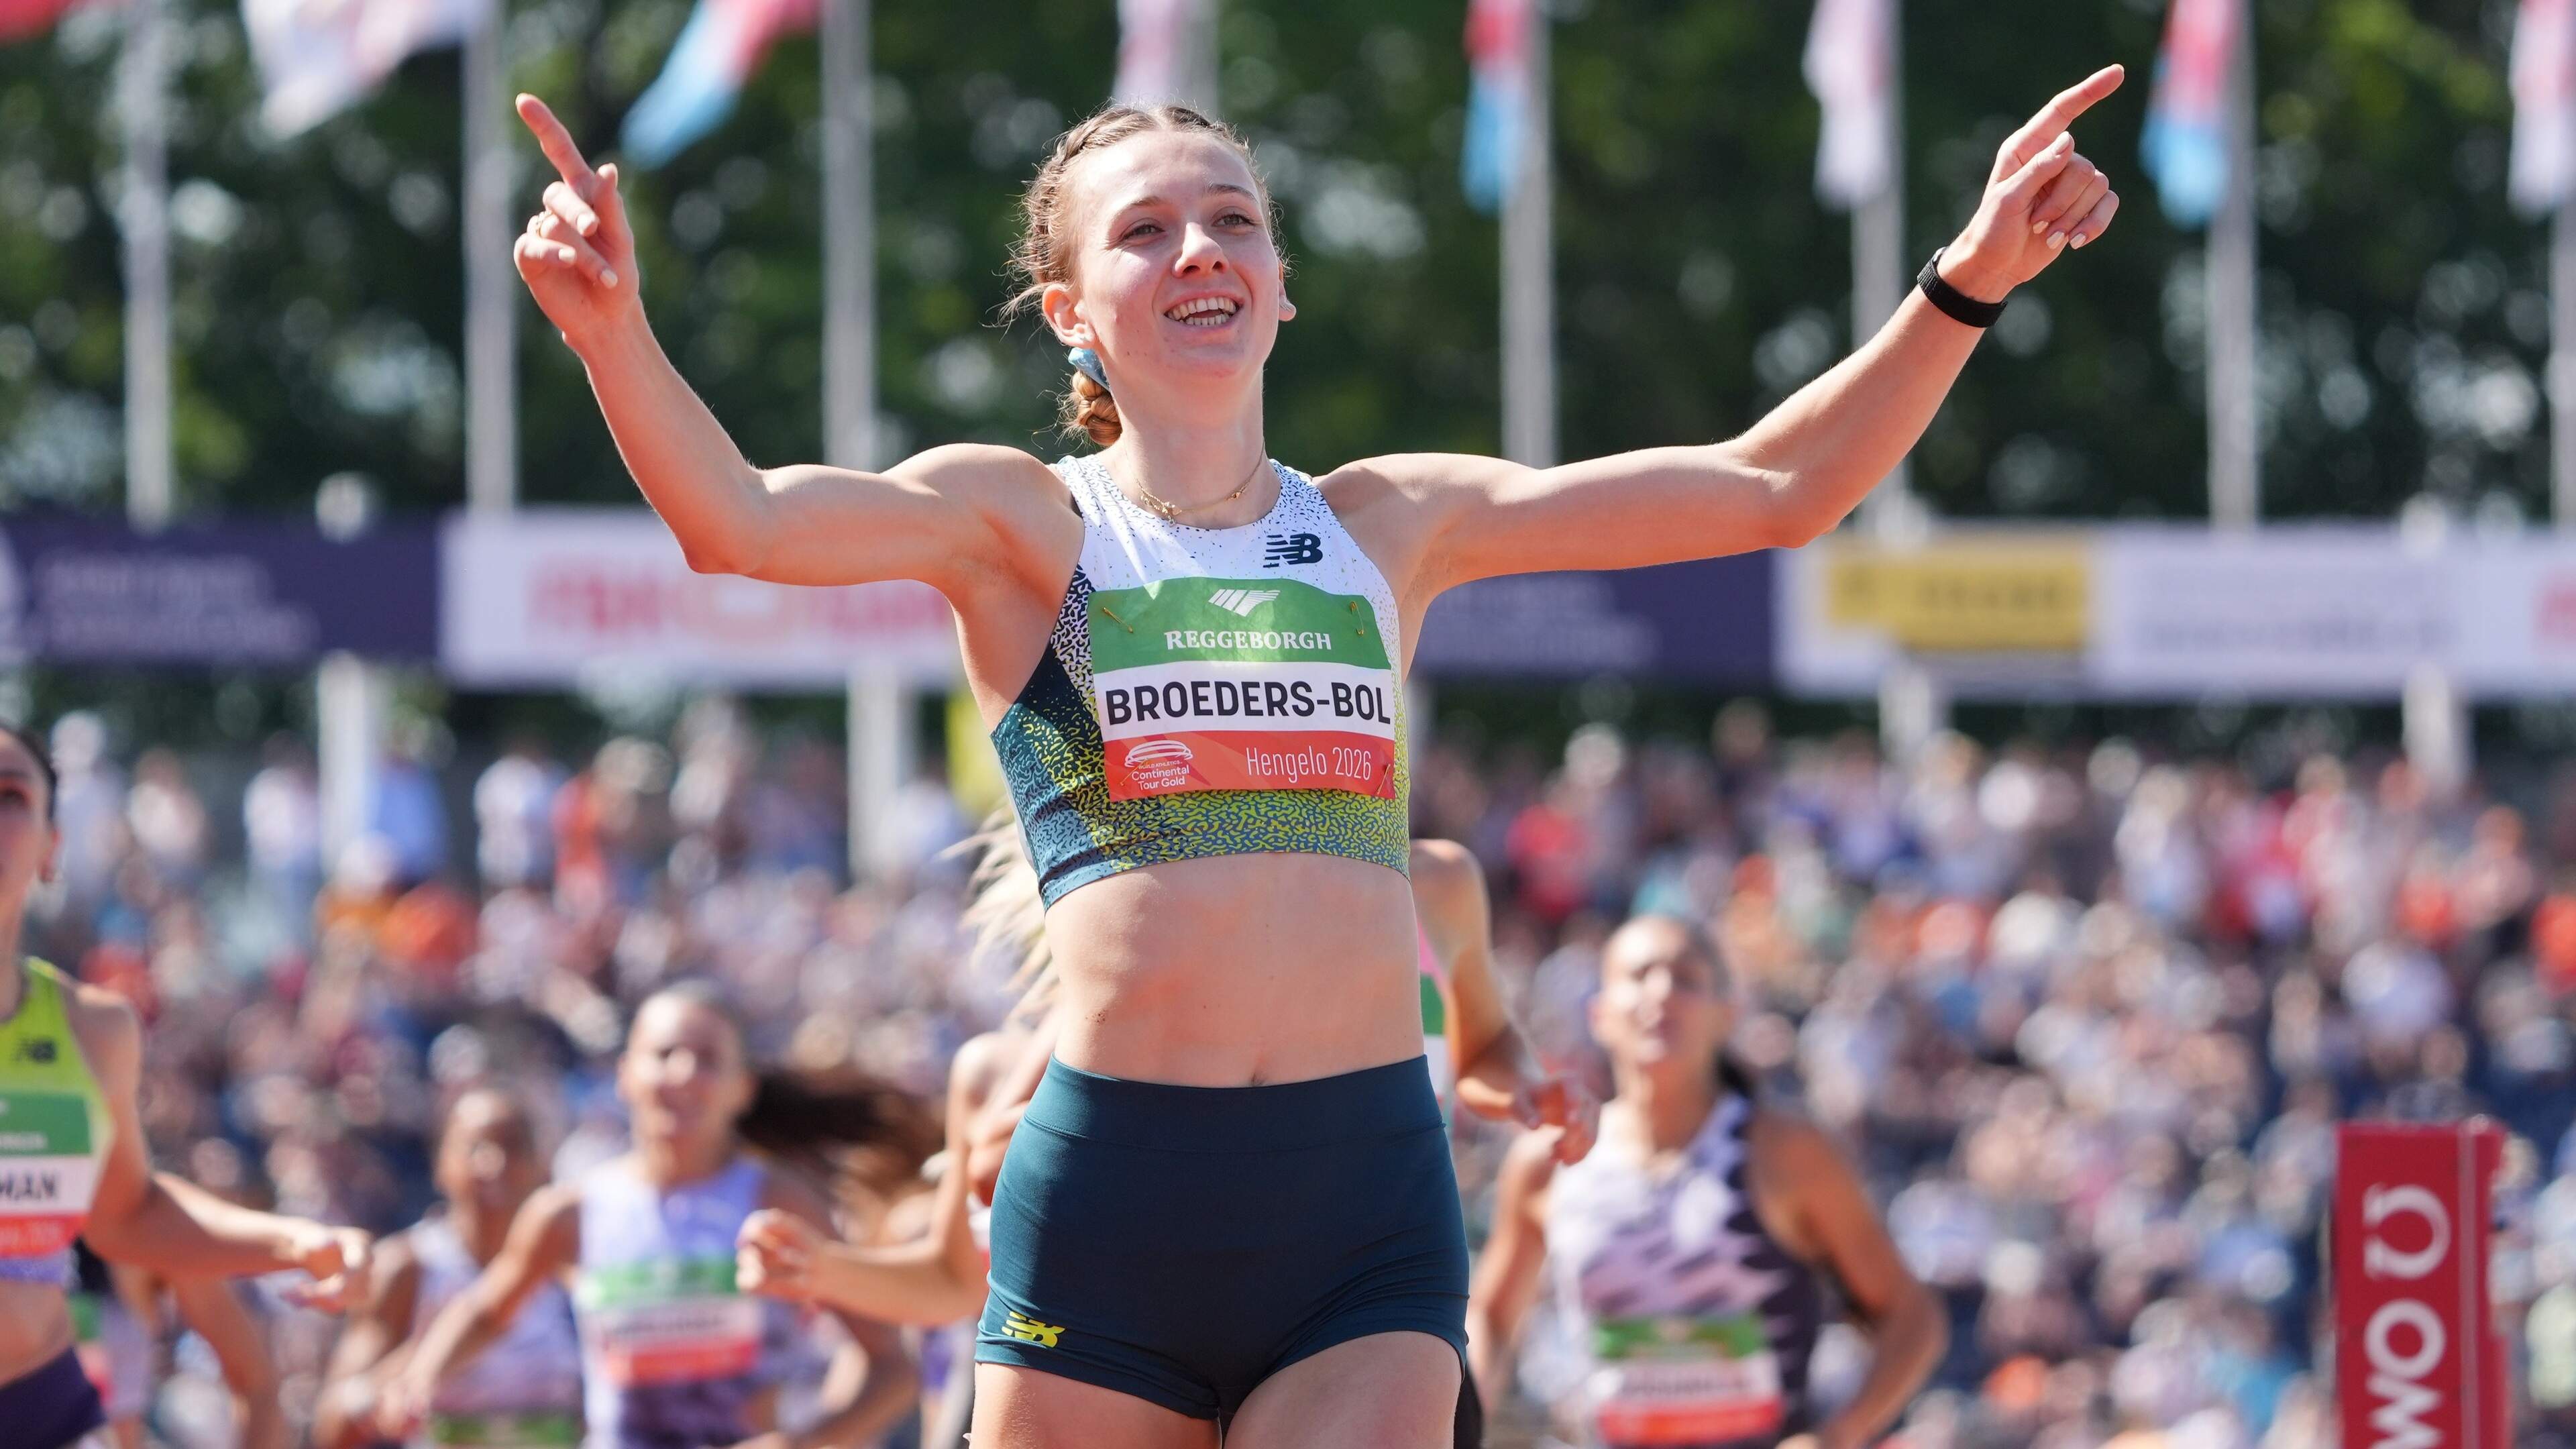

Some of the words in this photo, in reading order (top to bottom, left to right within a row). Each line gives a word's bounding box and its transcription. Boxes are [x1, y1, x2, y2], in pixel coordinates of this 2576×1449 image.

[1164, 630, 1332, 651] REGGEBORGH
[1105, 680, 1391, 726] BROEDERS-BOL
[1131, 764, 1189, 781] Continental
[1246, 745, 1328, 784] Hengelo
[1332, 747, 1372, 780] 2026
[1137, 780, 1160, 790] Tour
[1161, 775, 1186, 788] Gold
